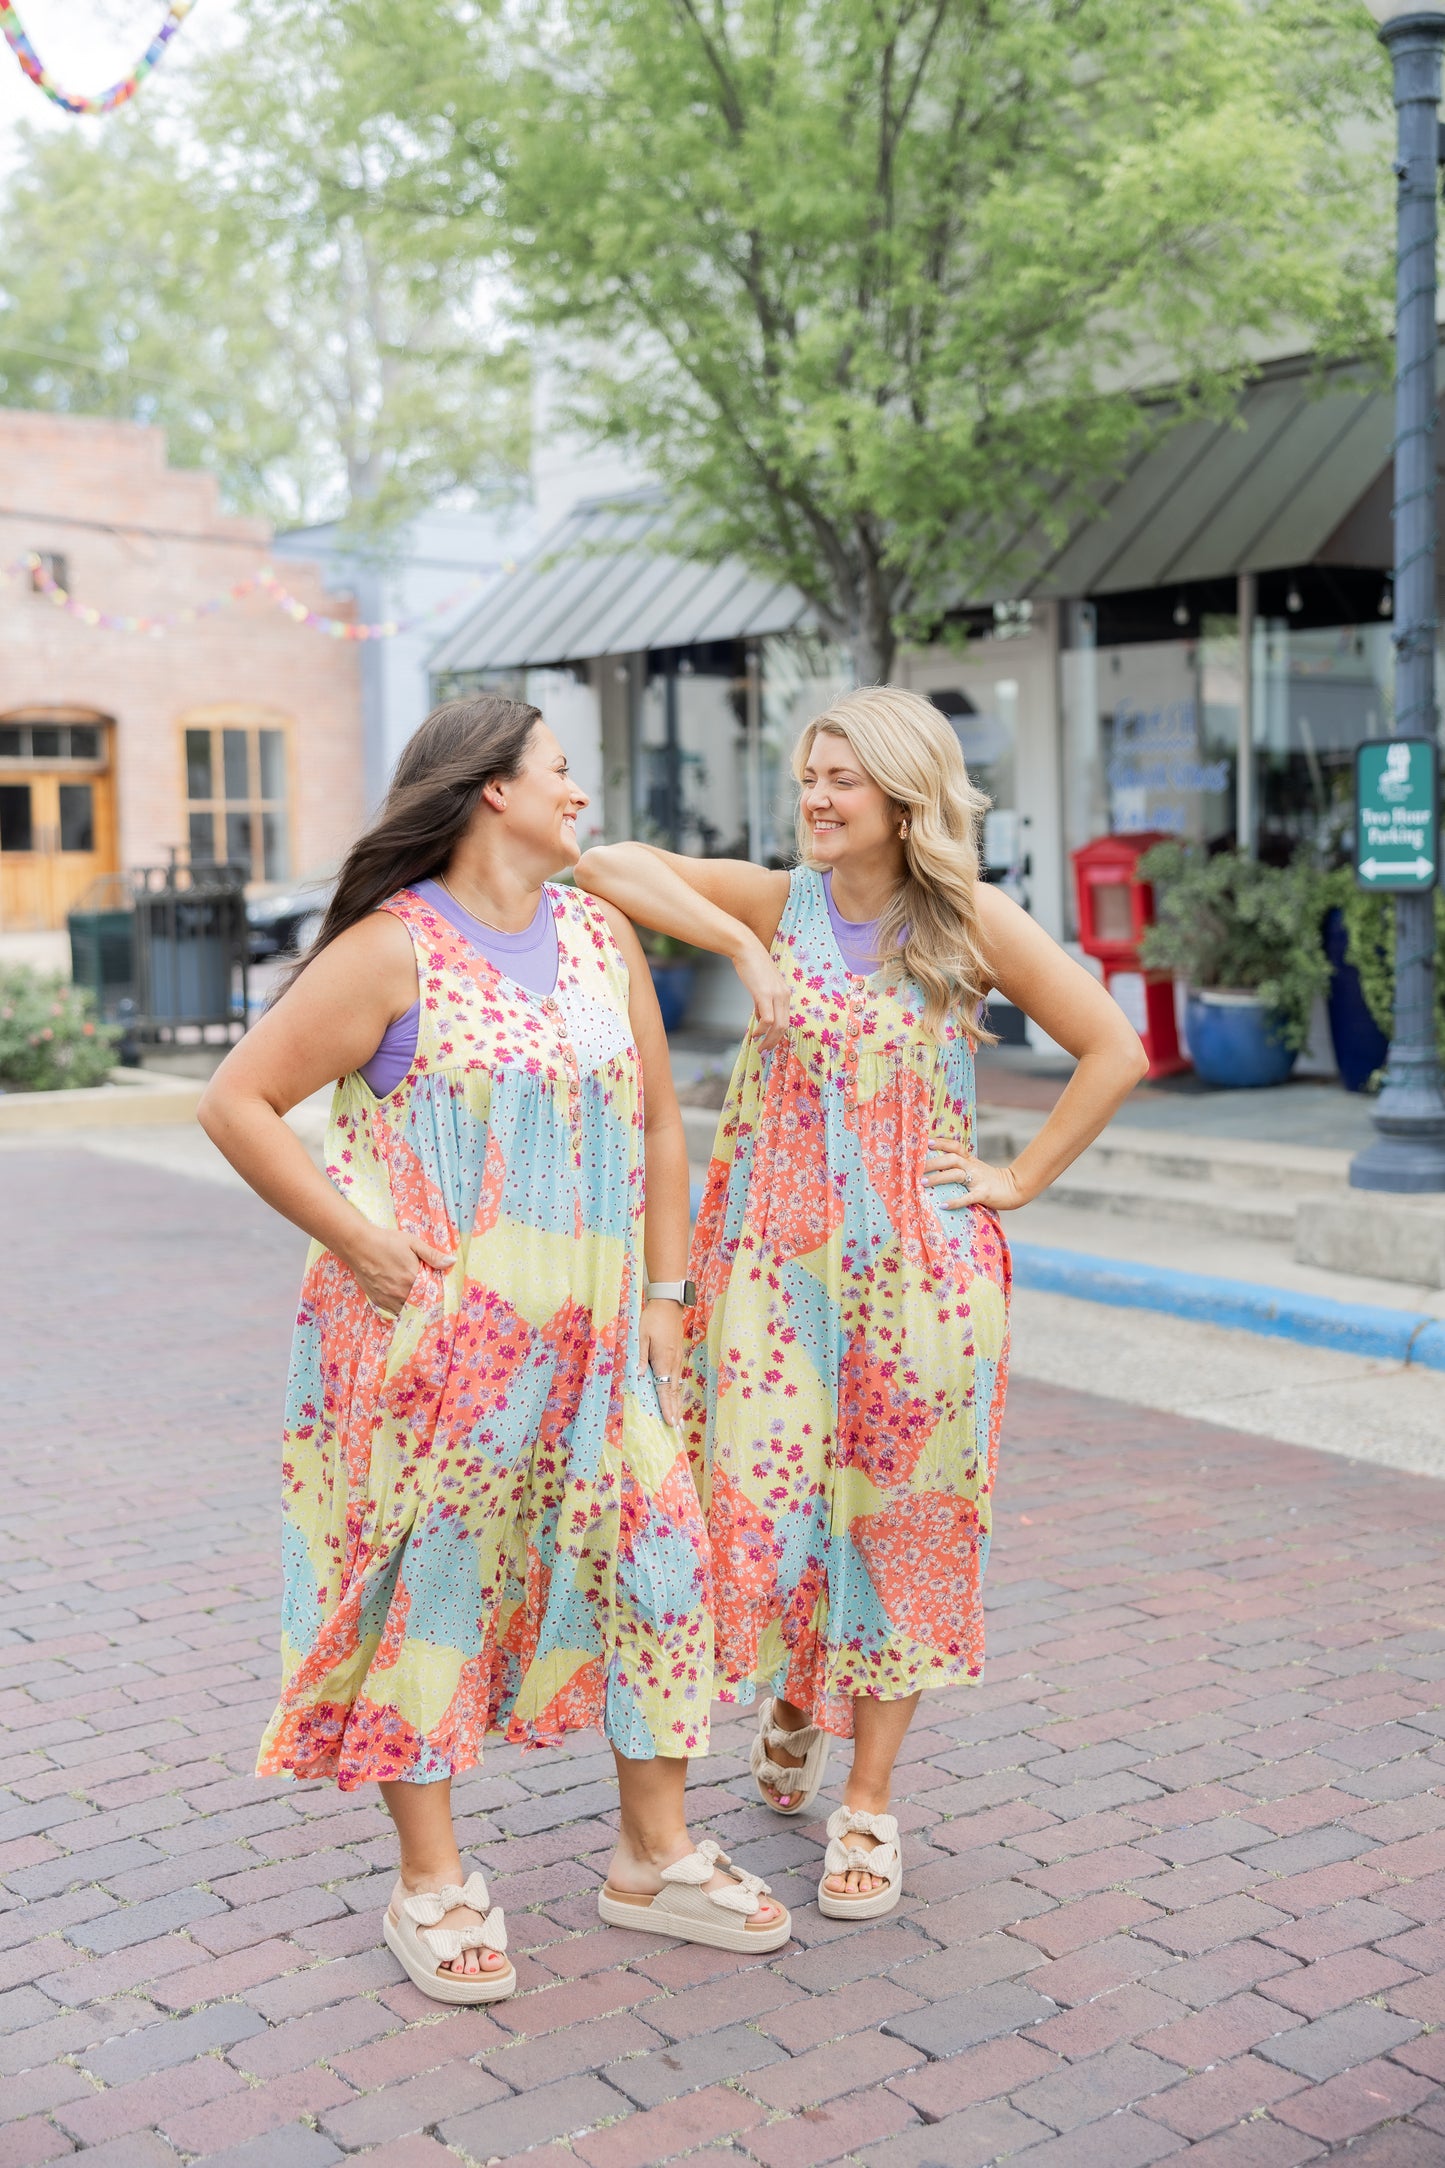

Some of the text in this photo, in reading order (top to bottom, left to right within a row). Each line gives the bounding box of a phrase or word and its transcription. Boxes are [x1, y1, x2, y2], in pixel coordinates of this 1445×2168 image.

[1362, 807, 1430, 826] Two Hour
[1368, 826, 1424, 850] Parking
